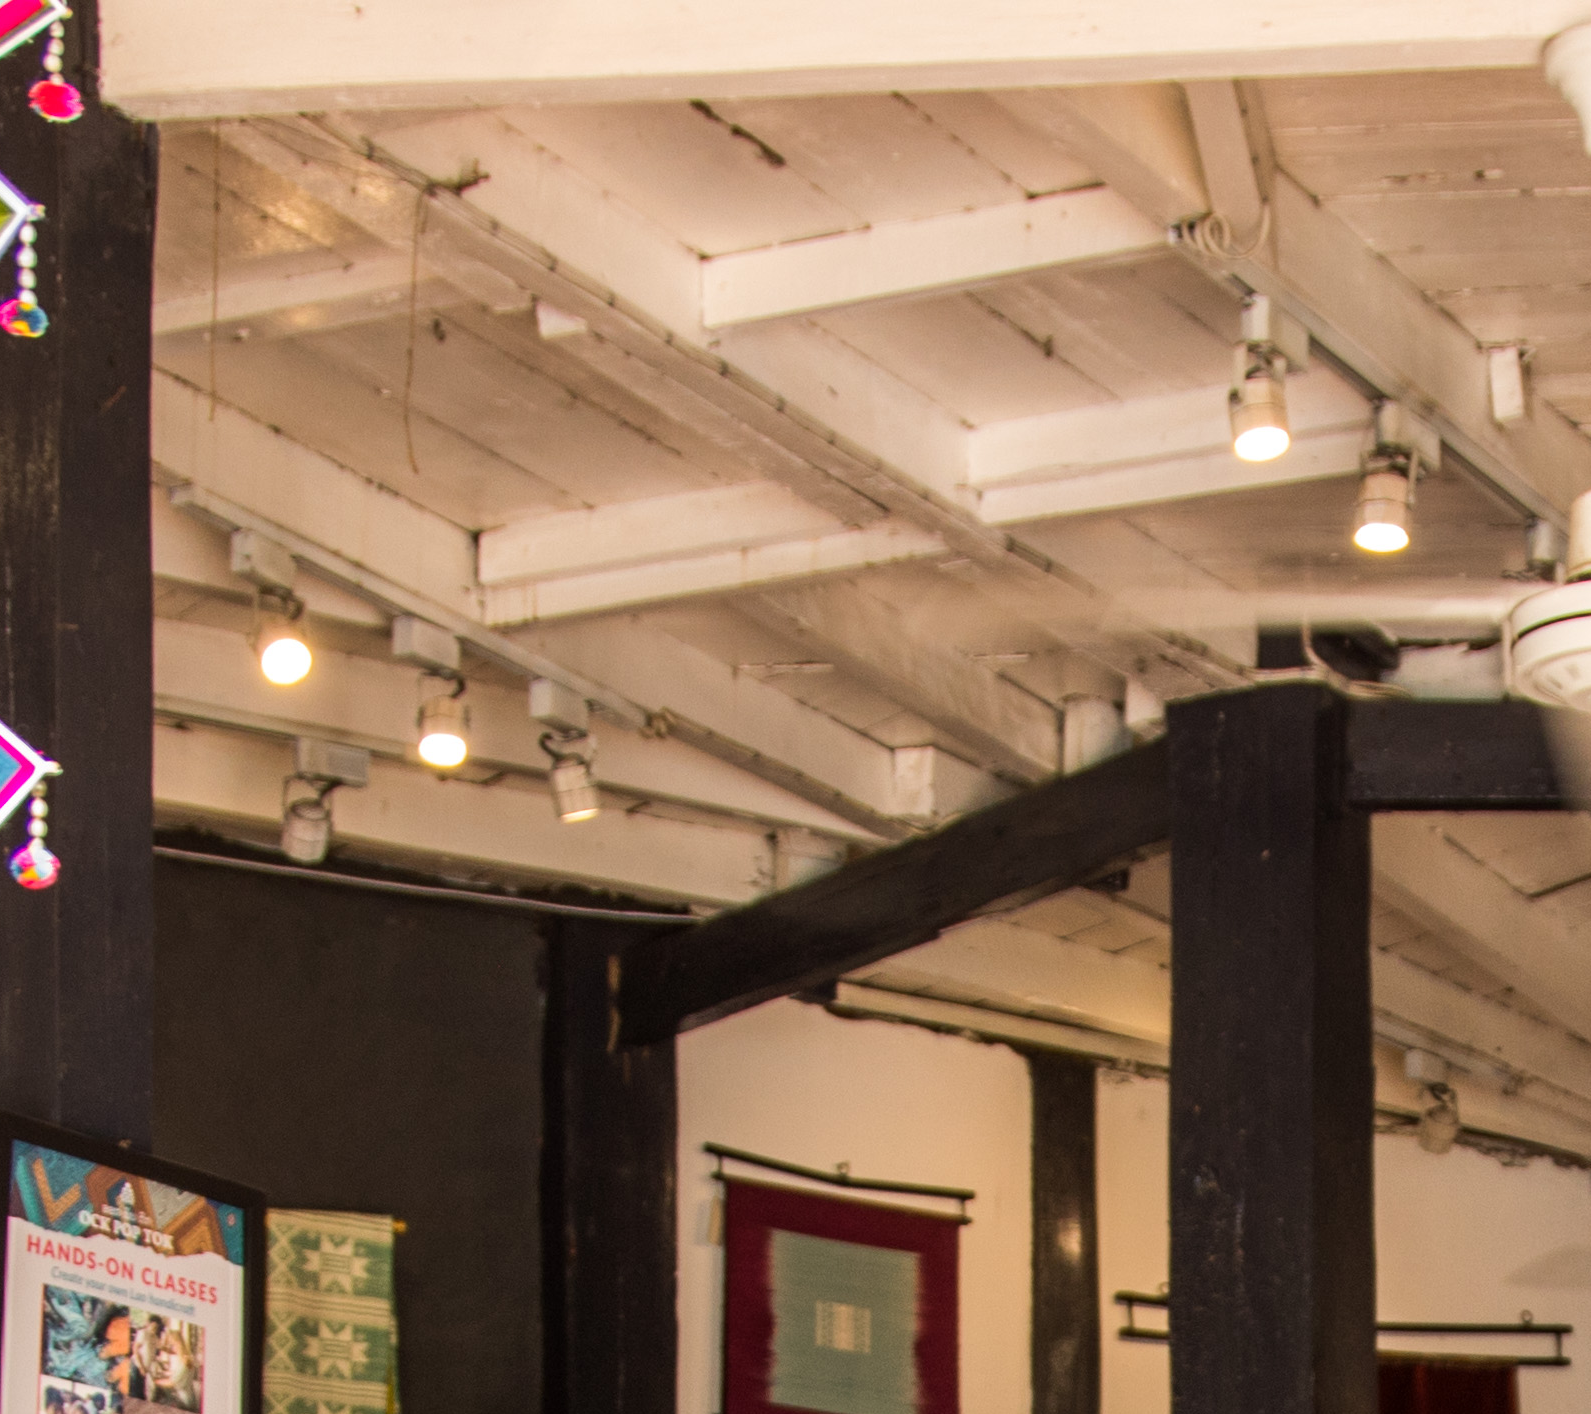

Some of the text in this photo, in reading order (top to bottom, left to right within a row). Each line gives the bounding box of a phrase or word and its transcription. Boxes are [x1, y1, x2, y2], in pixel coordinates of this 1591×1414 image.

[78, 1209, 111, 1233] OCK
[112, 1219, 141, 1240] POP
[143, 1227, 174, 1250] TOK
[27, 1235, 218, 1304] HANDS-ON CLASSES
